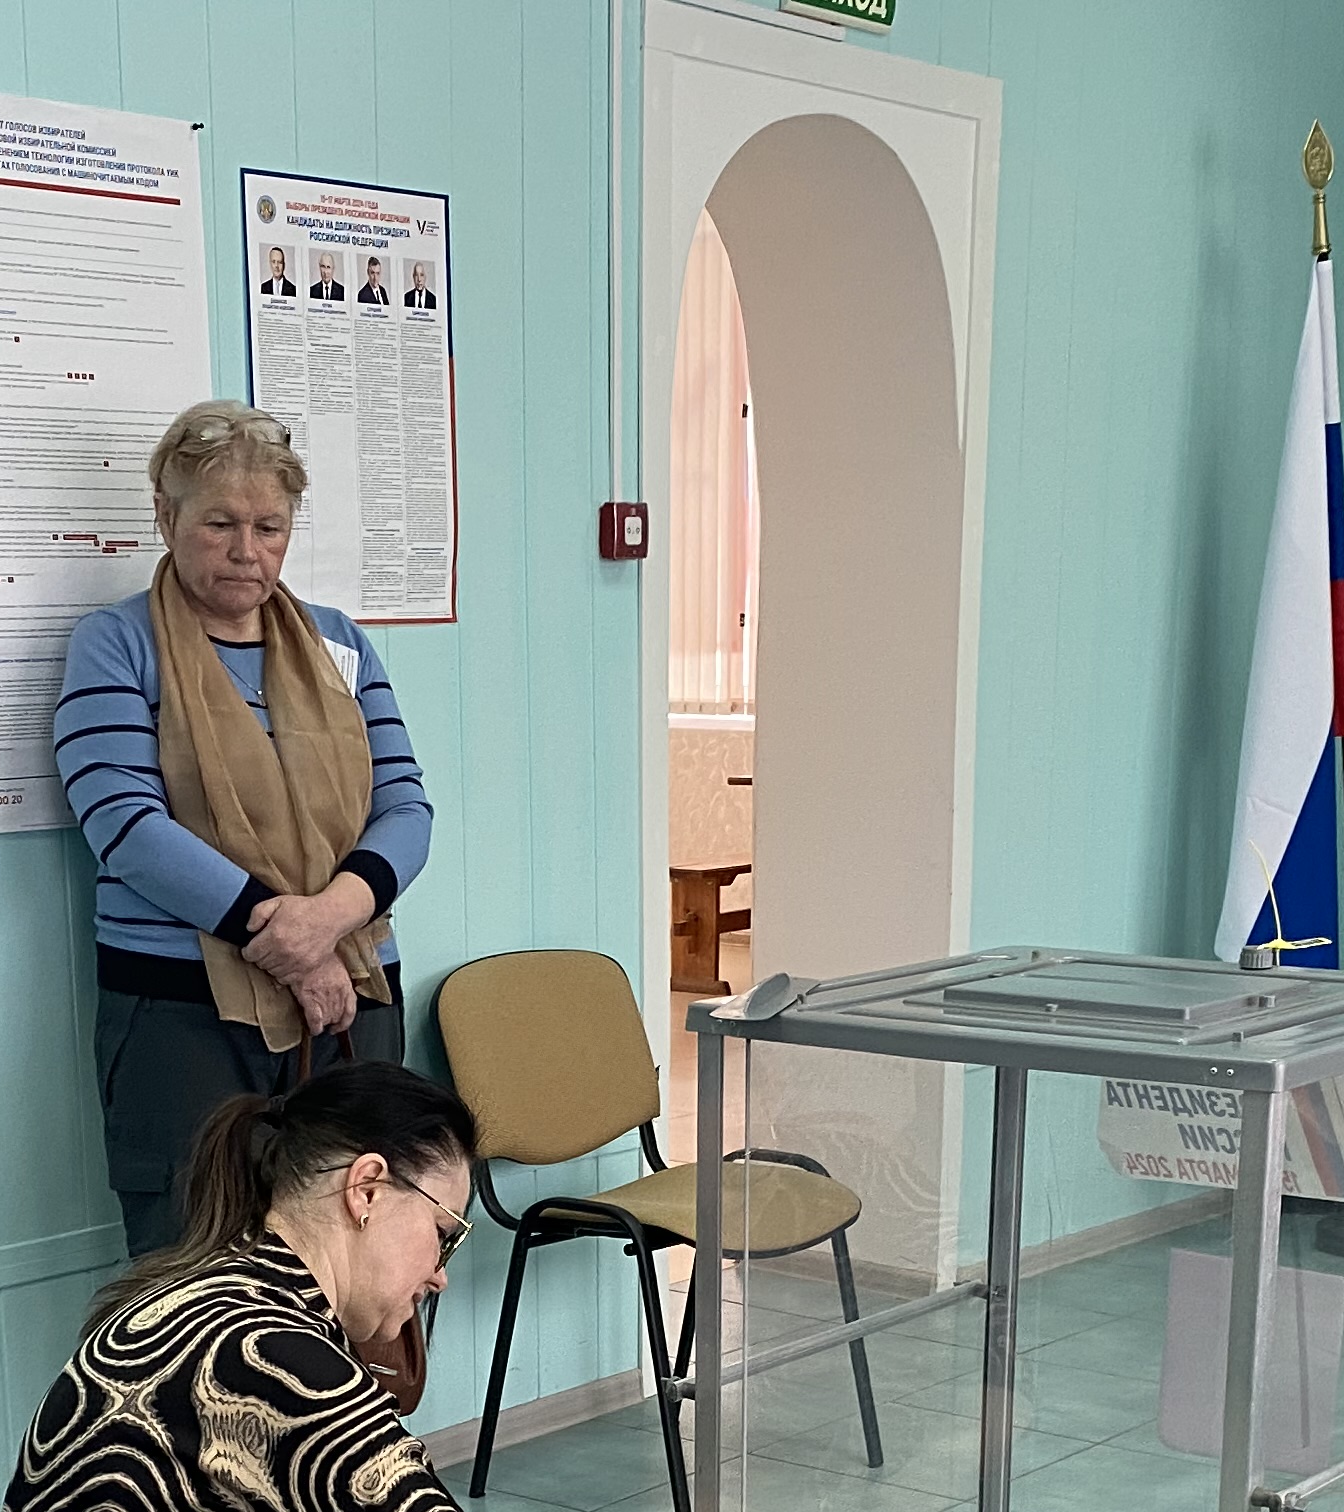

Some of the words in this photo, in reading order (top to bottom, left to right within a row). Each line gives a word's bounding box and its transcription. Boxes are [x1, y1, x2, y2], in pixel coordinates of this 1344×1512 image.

[5, 121, 37, 133] ГОЛОСОВ
[38, 126, 86, 140] ИЗБИРАТЕЛЕЙ
[18, 137, 75, 152] ИЗБИРАТЕЛЬНОЙ
[76, 144, 116, 157] КОМИССИЕЙ
[12, 162, 61, 176] ГОЛОСОВАНИЯ
[31, 151, 75, 165] ТЕХНОЛОГИИ
[127, 163, 165, 177] ПРОТОКОЛА
[325, 220, 334, 229] НА
[11, 794, 23, 804] 20
